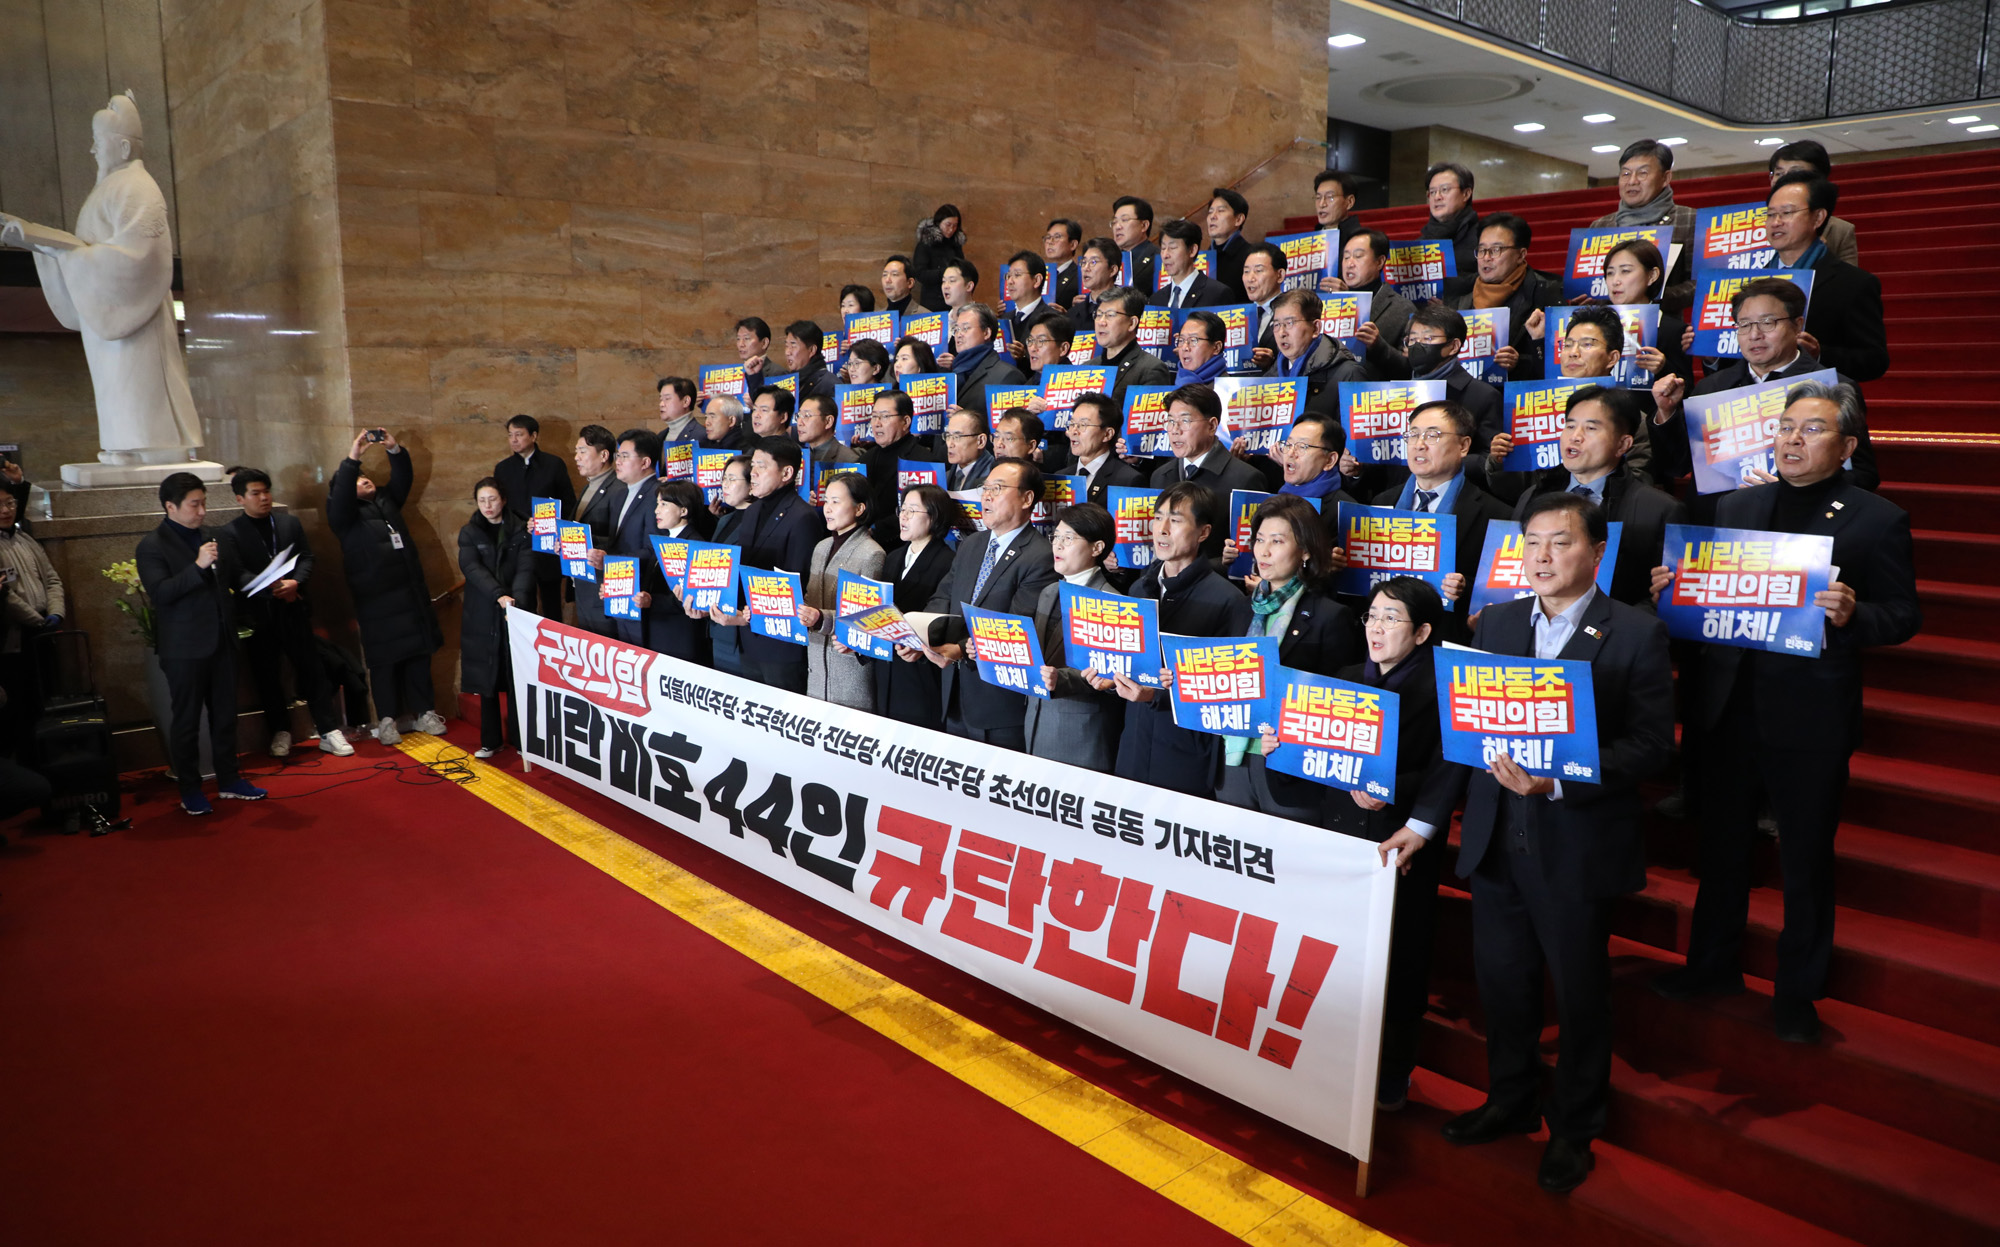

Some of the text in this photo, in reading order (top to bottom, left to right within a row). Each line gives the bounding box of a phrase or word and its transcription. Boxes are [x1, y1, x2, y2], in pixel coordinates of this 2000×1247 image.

[1286, 251, 1324, 273] 민의힘
[1386, 243, 1441, 265] 내란동조
[1385, 262, 1443, 284] 국민의힘
[1401, 283, 1437, 300] 해체!
[850, 314, 891, 333] 내란동조
[906, 315, 942, 335] 내란동조
[705, 366, 744, 383] 내란동조
[1049, 369, 1105, 389] 내란동조
[906, 377, 946, 396] 내란동조
[1229, 381, 1295, 407] 내란동조
[917, 414, 941, 432] 해체!
[1228, 404, 1293, 428] 국민의힘
[1244, 429, 1282, 450] 해체!
[667, 444, 692, 462] 내란동조
[535, 502, 555, 518] 내란동조
[535, 517, 556, 534] 국민의힘
[560, 527, 584, 542] 내란동조
[1350, 516, 1436, 542] 내란동조
[562, 542, 587, 559] 국민의힘
[659, 543, 689, 558] 내란동
[693, 549, 731, 567] 내란동조
[1350, 542, 1435, 570] 국민의힘
[570, 561, 585, 576] 해체!
[605, 561, 634, 578] 내란동조
[689, 568, 729, 587] 국민의힘
[604, 578, 633, 596] 국민의힘
[748, 576, 791, 594] 내란동조
[843, 581, 879, 605] 내란동조
[1679, 572, 1801, 606] 국민의힘
[610, 598, 629, 614] 해체!
[697, 590, 721, 607] 해체!
[751, 594, 794, 615] 국민의힘
[1071, 596, 1139, 625] 내란동조
[765, 617, 791, 637] 해체!
[971, 616, 1025, 641] 내란동조
[1073, 619, 1141, 652] 국민의힘
[1703, 609, 1782, 642] 해체!
[848, 629, 871, 650] 해체!
[1785, 637, 1813, 651] 민주당
[976, 638, 1031, 665] 국민의힘
[1176, 643, 1259, 673] 내란동조
[538, 628, 649, 708] 국민의힘
[1089, 651, 1132, 678] 해체!
[994, 665, 1028, 689] 해체!
[1138, 673, 1158, 684] 민주당
[1180, 672, 1261, 700] 국민의힘
[1453, 666, 1566, 698] 내란동조
[1285, 684, 1380, 722] 내란동조
[1200, 704, 1250, 730] 해체!
[1455, 697, 1567, 733] 국민의힘
[1283, 712, 1378, 754] 국민의힘
[1482, 736, 1554, 770] 해체!
[1303, 749, 1363, 785] 해체!
[1563, 763, 1592, 777] 민주당
[1366, 781, 1389, 797] 민주당
[989, 774, 1084, 829] 초선의원
[1091, 800, 1144, 846] 공동
[1154, 818, 1275, 884] 기자회견
[868, 804, 1339, 1069] 규탄한다!
